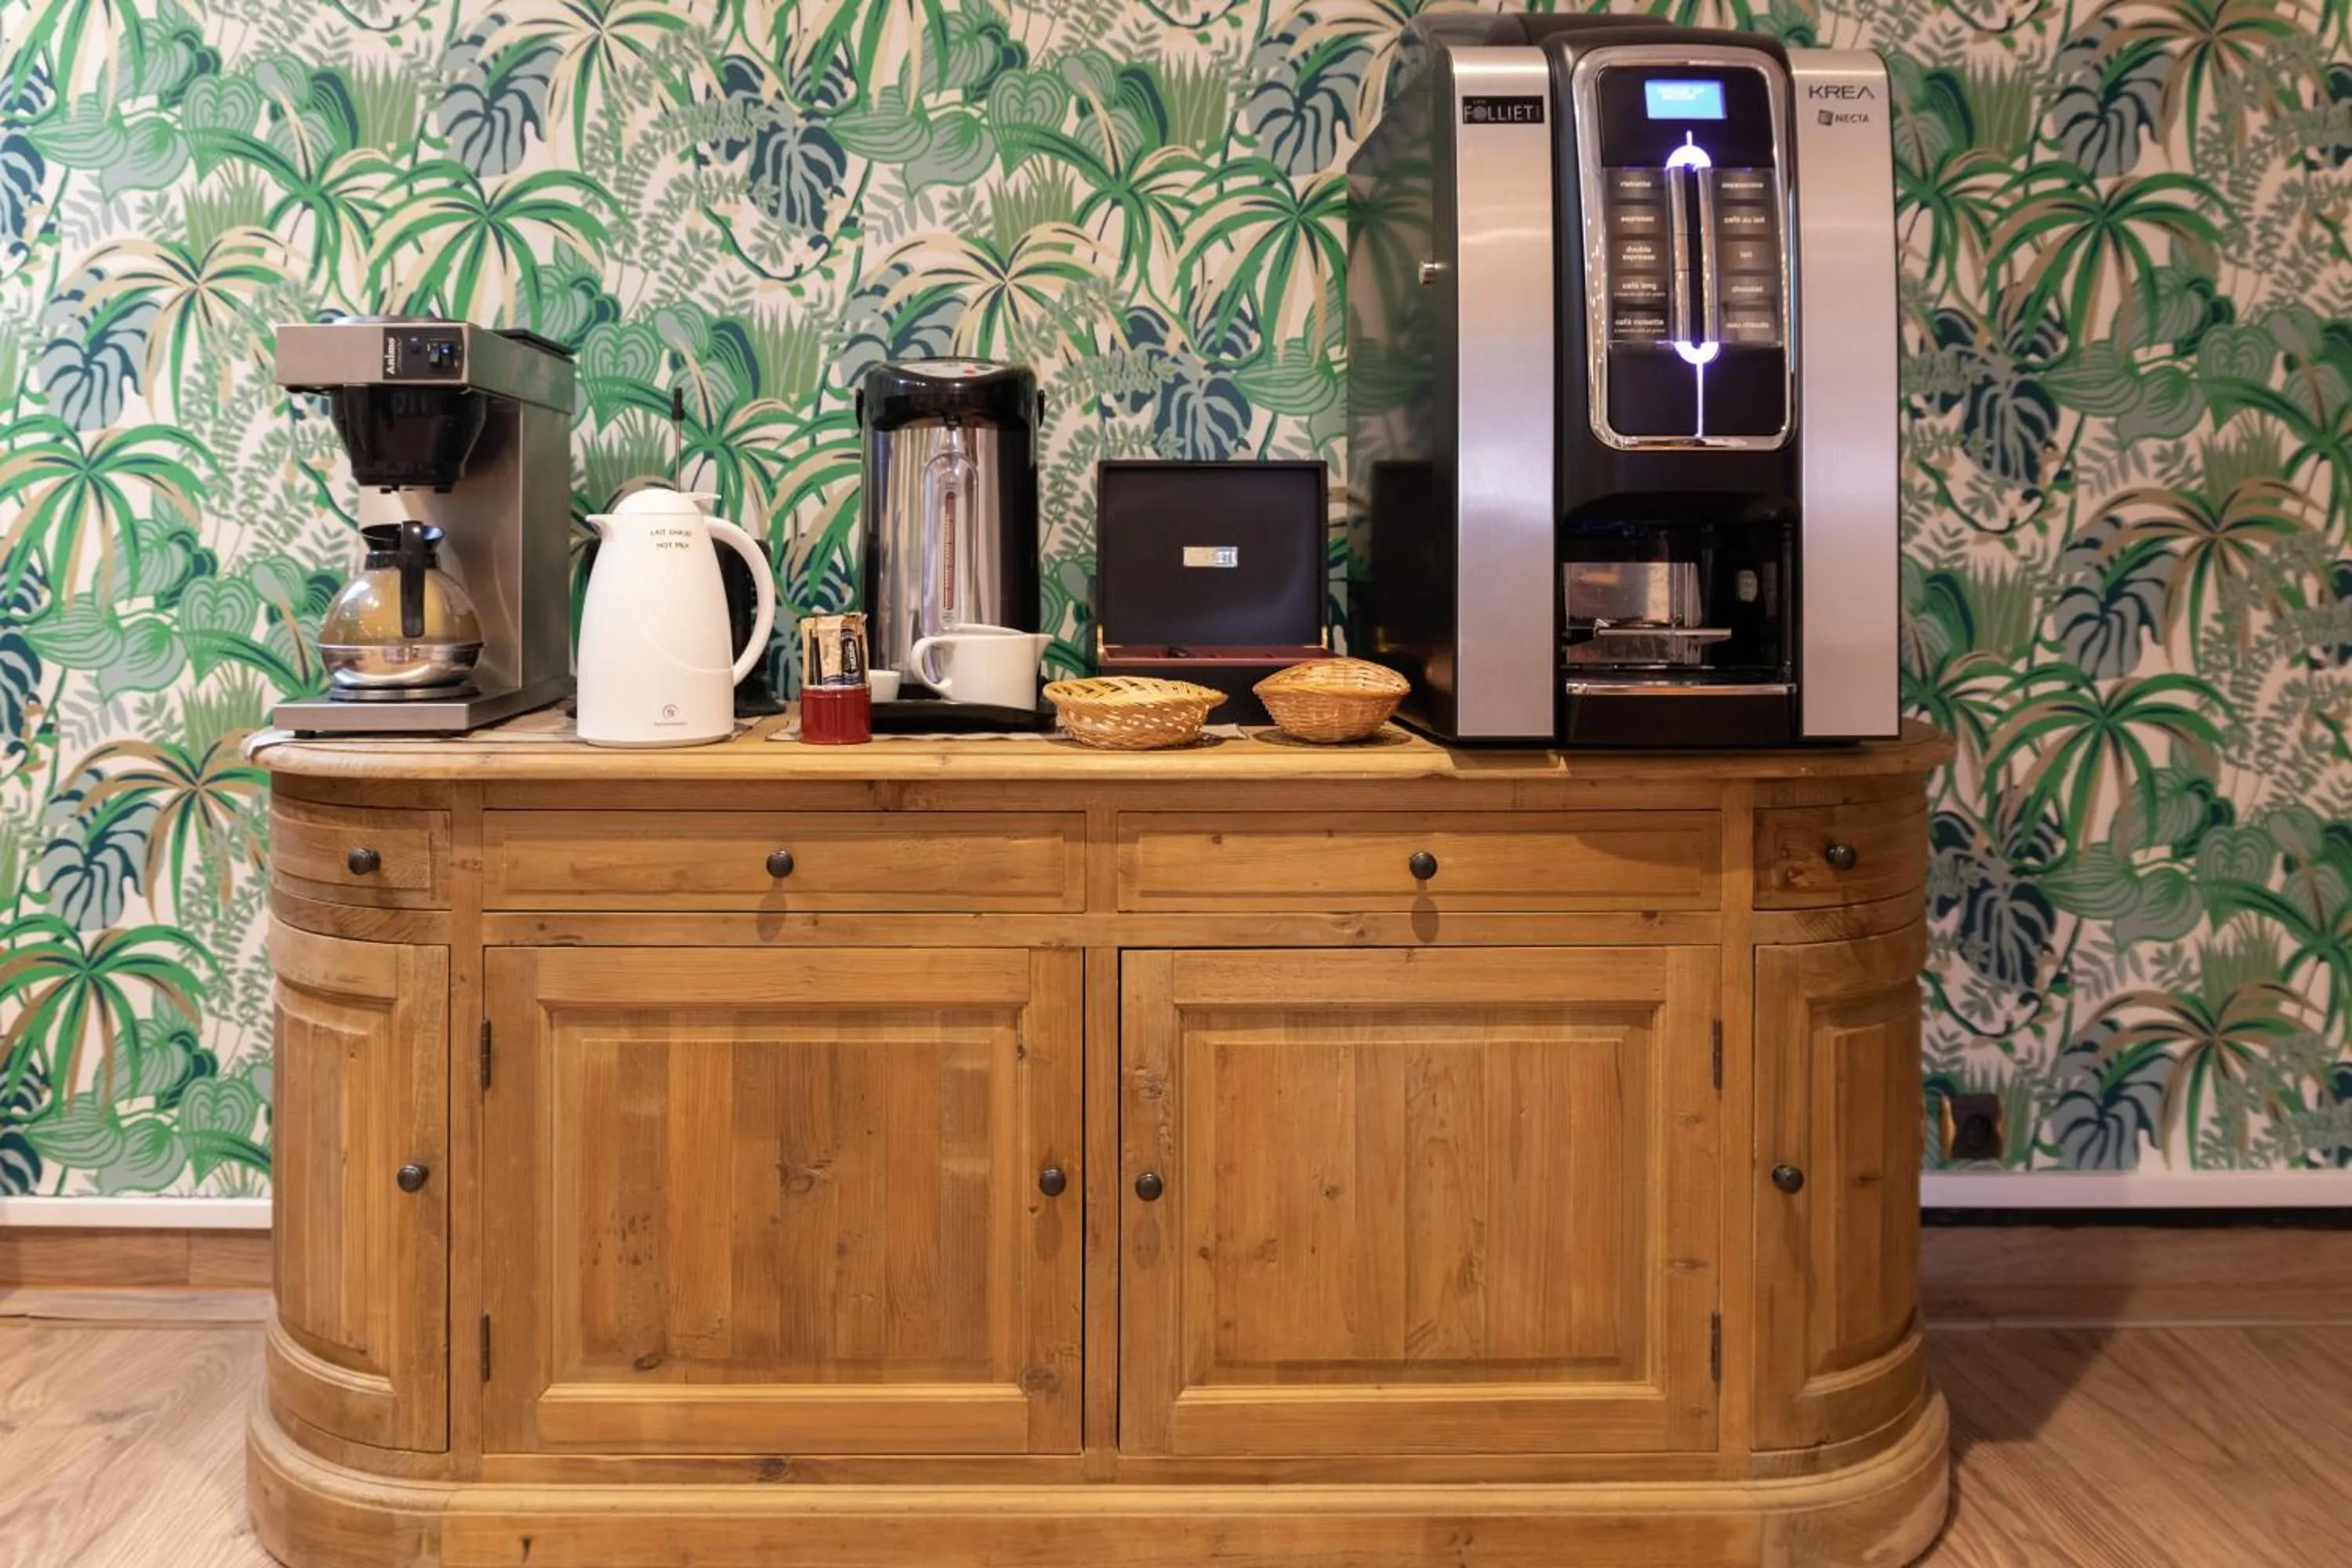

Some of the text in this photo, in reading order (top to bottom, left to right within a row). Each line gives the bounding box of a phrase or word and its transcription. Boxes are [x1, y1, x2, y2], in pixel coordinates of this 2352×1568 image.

[1809, 85, 1875, 100] KREA
[1835, 113, 1870, 124] NECTA
[1641, 282, 1657, 291] long
[383, 336, 396, 375] Animo
